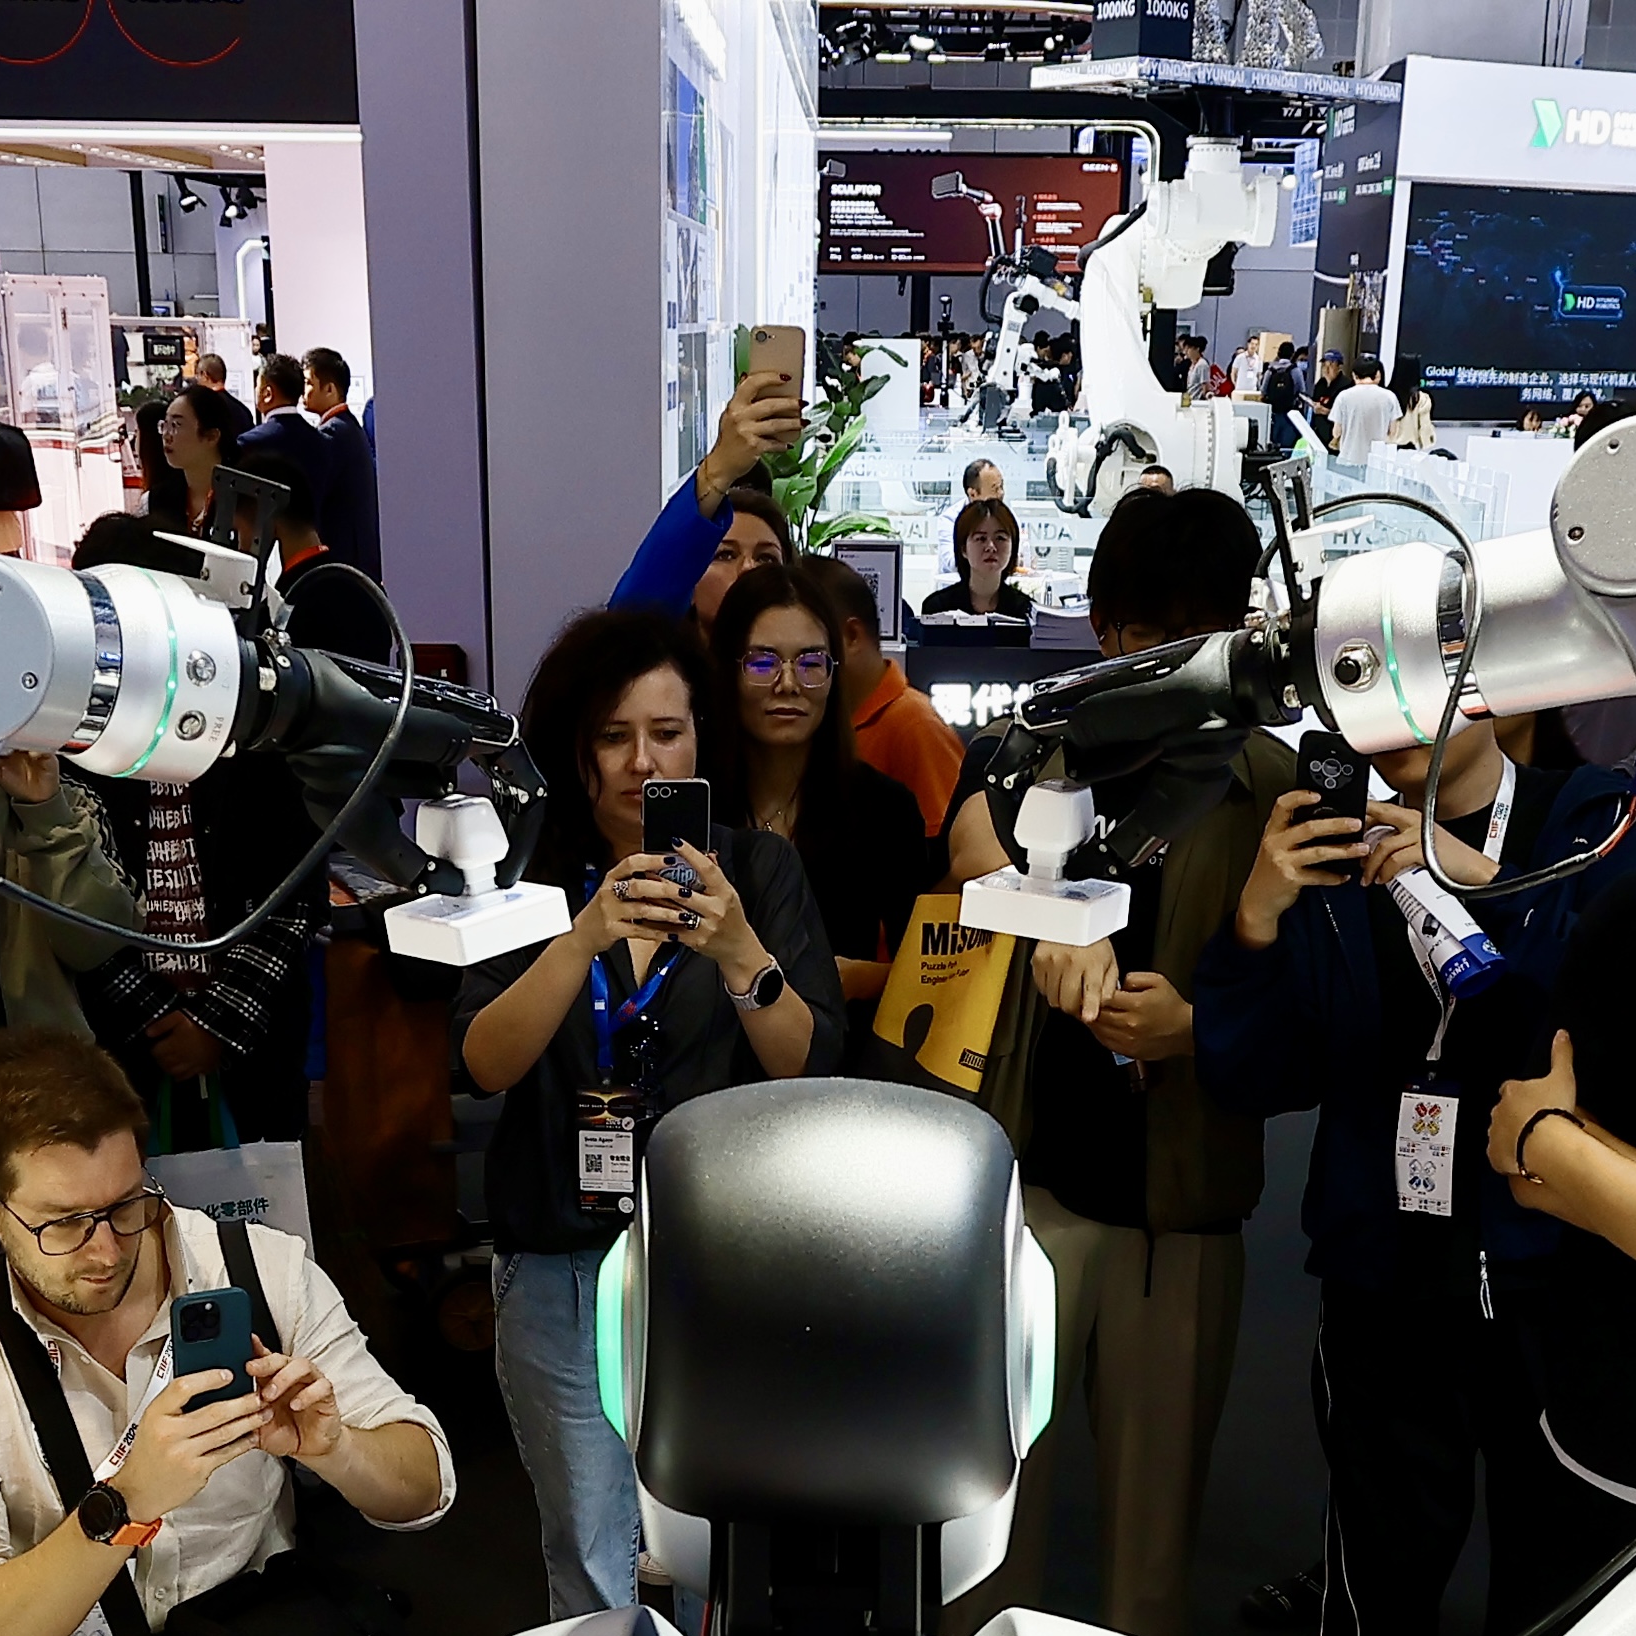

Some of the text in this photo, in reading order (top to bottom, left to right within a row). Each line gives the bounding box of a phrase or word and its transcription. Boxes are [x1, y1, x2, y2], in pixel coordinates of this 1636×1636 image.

[1096, 0, 1136, 19] 1000KG
[1146, 0, 1189, 19] 1000KG
[1087, 60, 1139, 77] HYUNDAI
[1141, 58, 1400, 98] HYUNDAI HYUNDAI HYUNDAI HYUNDAI HYUNDAI
[1565, 107, 1612, 146] HD
[830, 184, 882, 196] SCULPTOR
[1576, 296, 1595, 309] HD
[1425, 366, 1456, 377] Global
[1488, 802, 1506, 839] CIIF 2026
[197, 1197, 270, 1220] 化零部件
